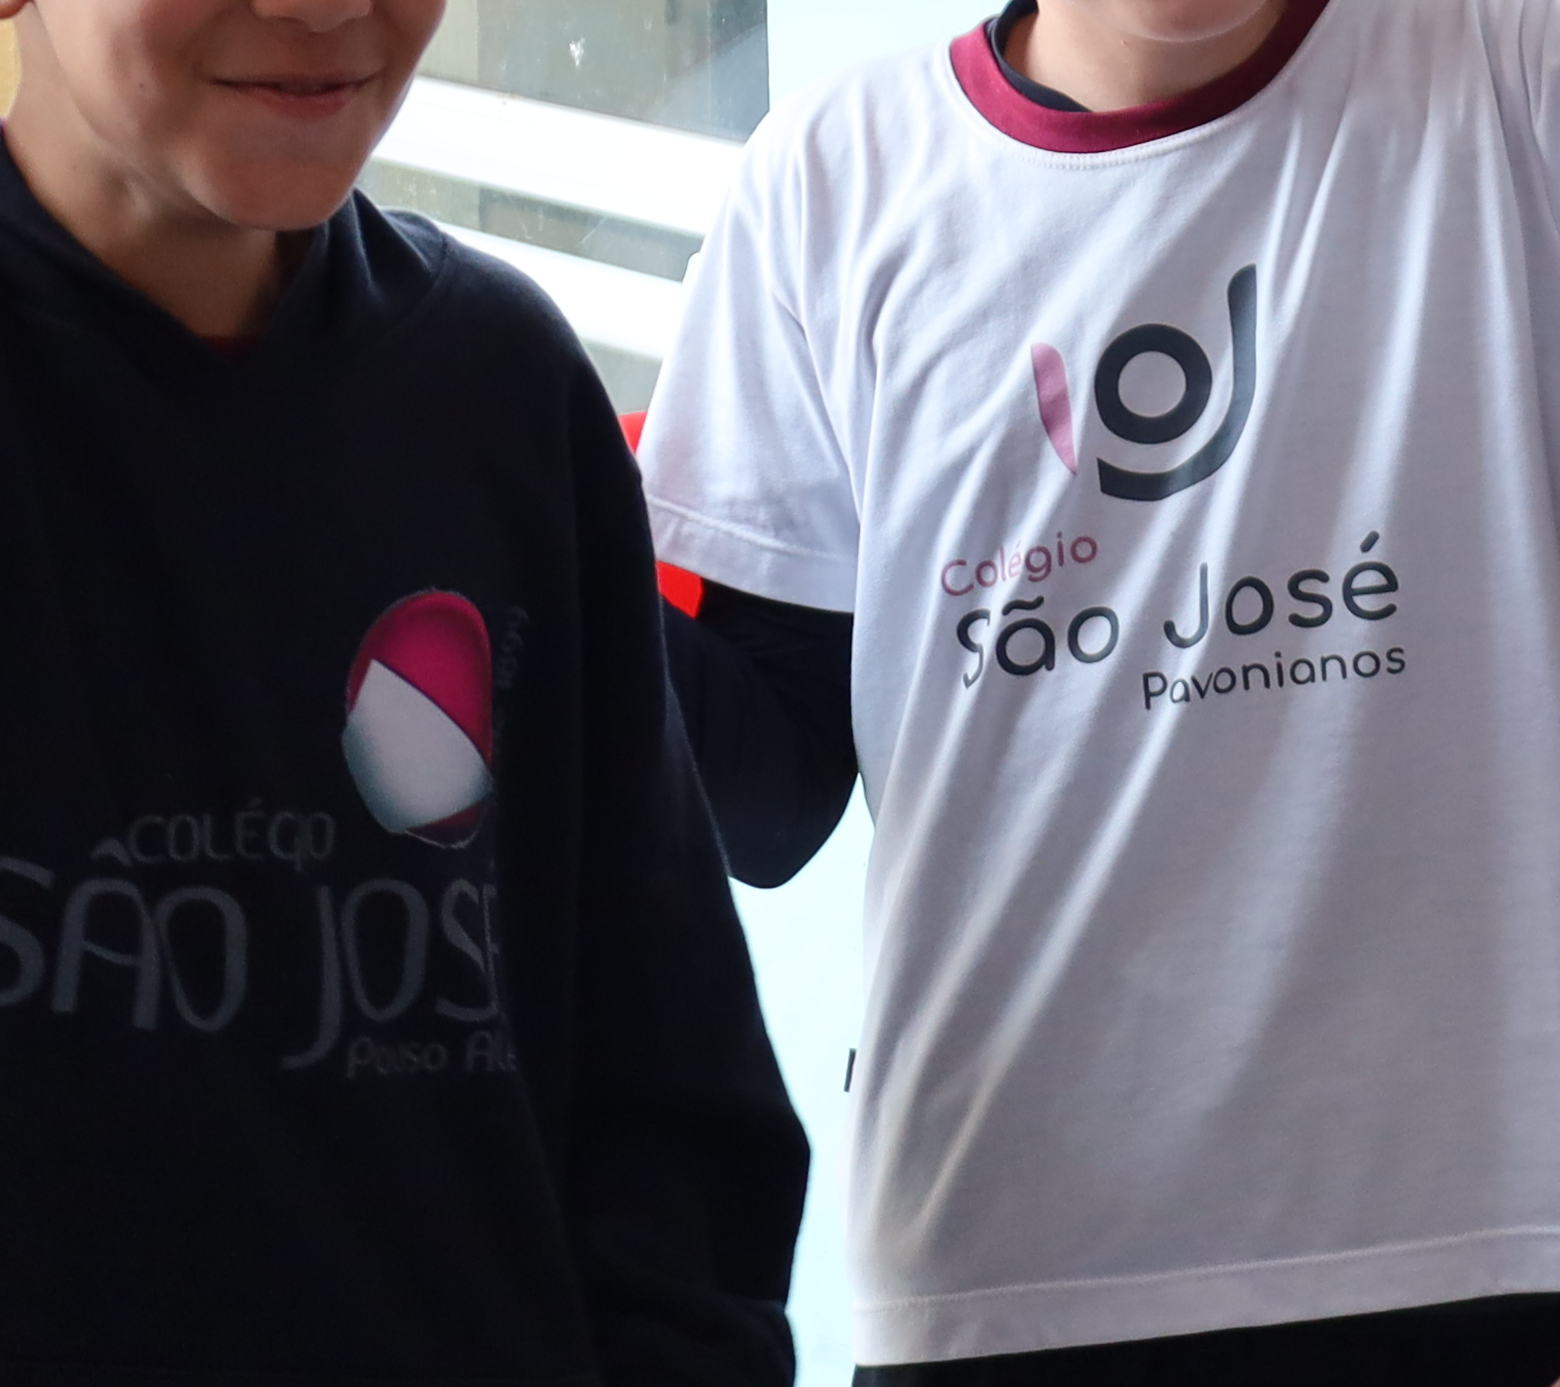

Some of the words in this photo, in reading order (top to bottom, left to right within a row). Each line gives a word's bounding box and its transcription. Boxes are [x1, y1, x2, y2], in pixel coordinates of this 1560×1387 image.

[940, 531, 1098, 597] Colégio
[955, 595, 1120, 690] São
[1163, 530, 1400, 649] José
[1141, 644, 1407, 710] Pavonianos
